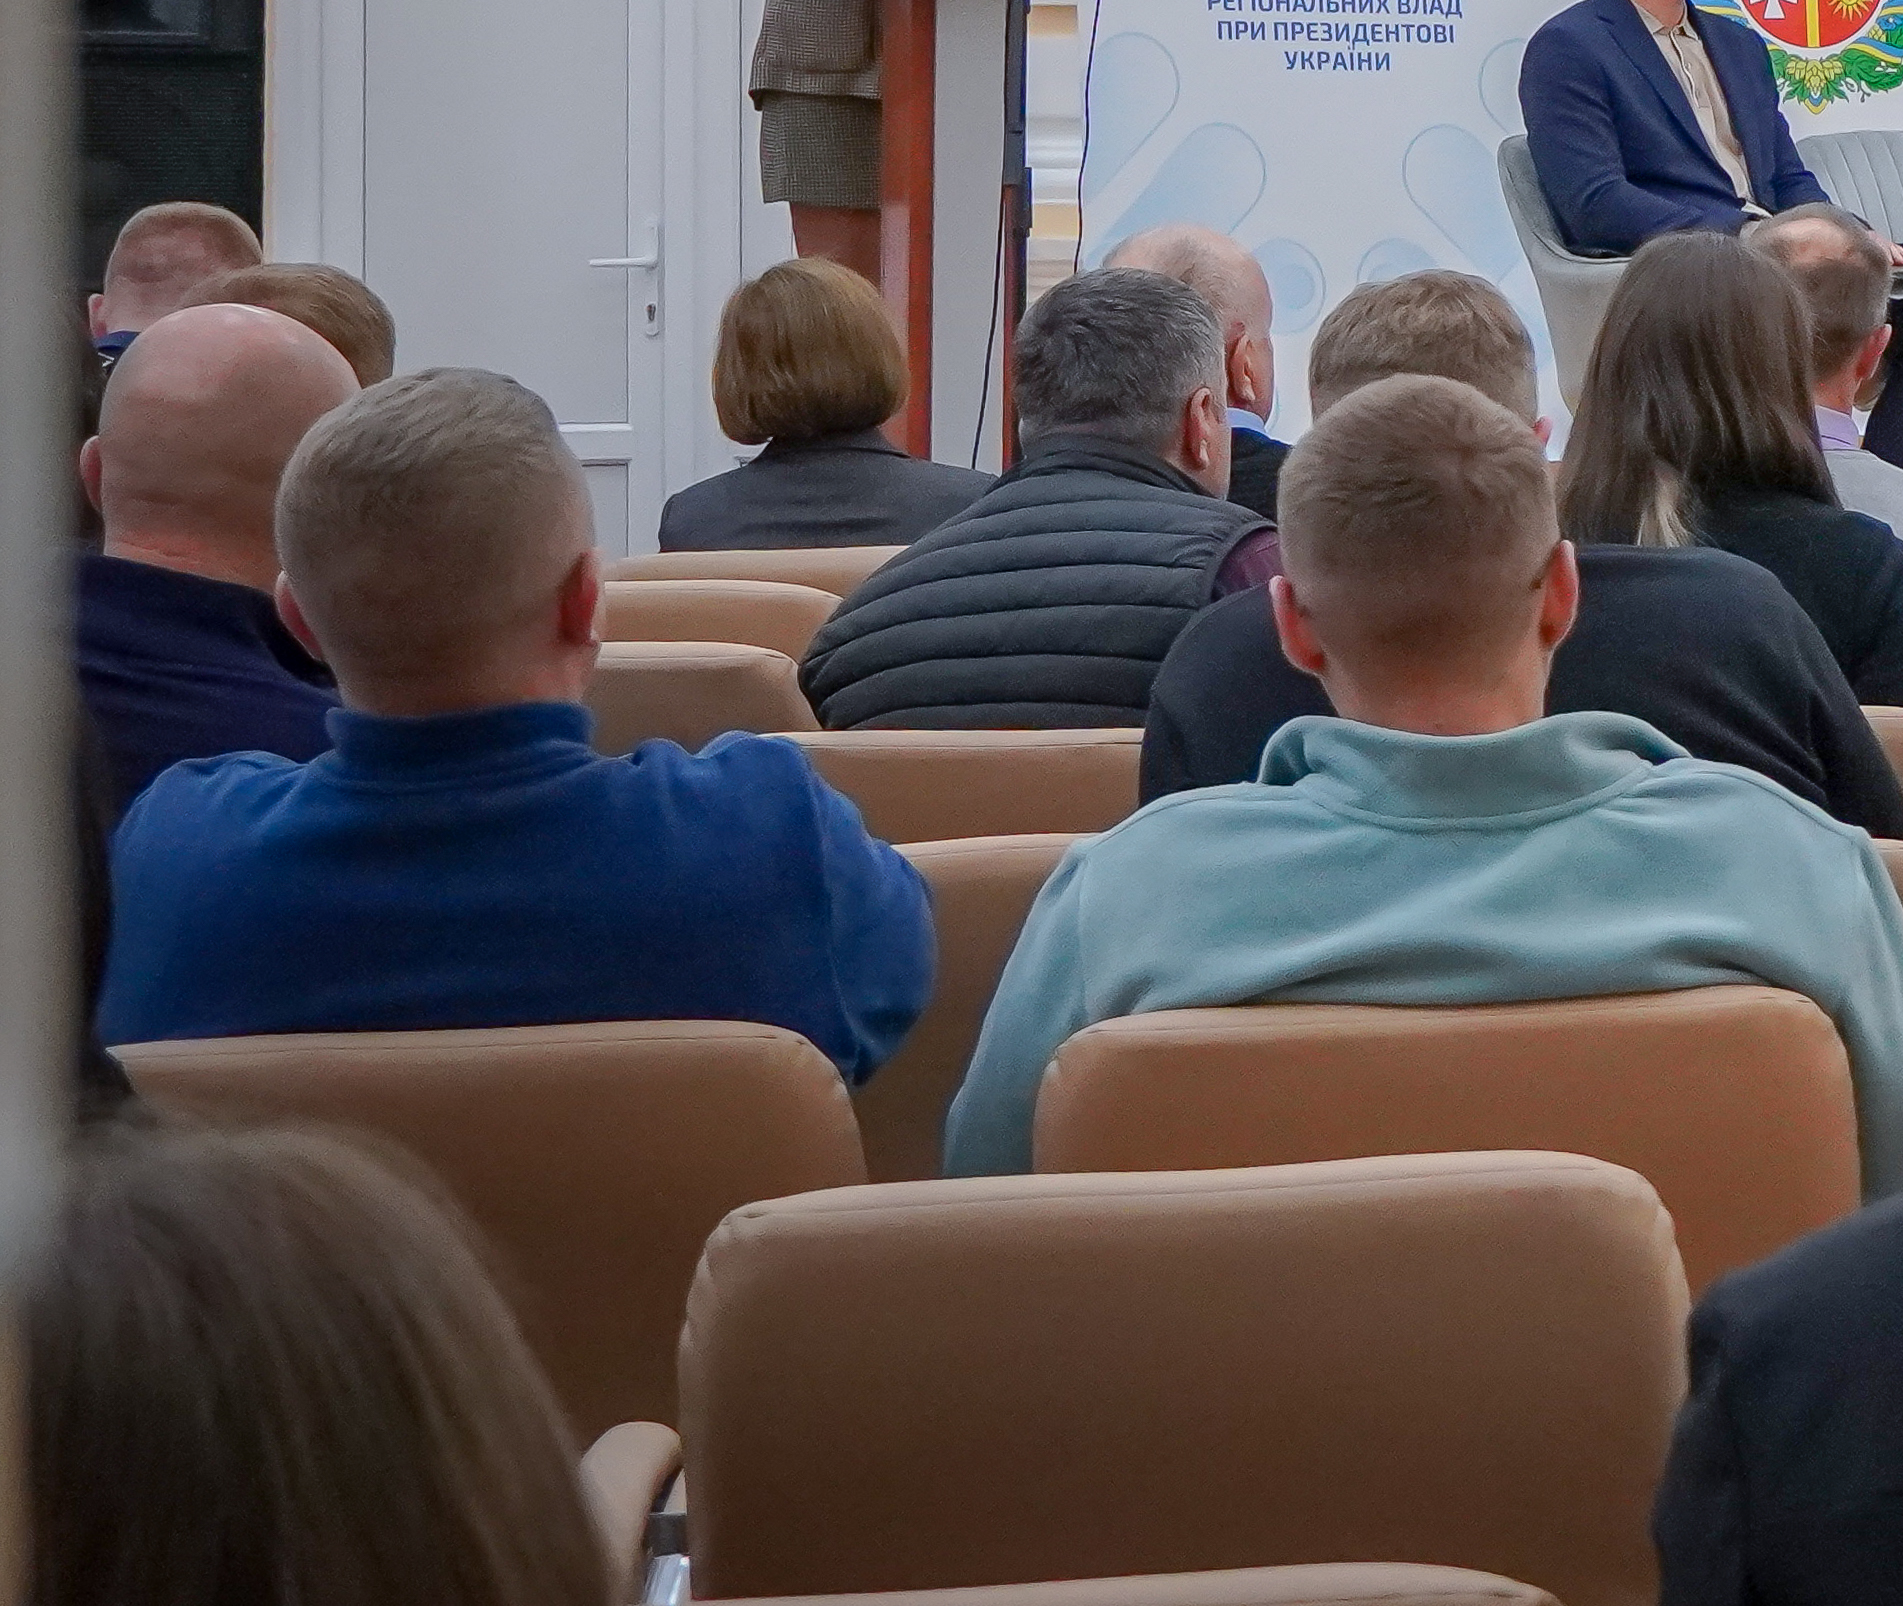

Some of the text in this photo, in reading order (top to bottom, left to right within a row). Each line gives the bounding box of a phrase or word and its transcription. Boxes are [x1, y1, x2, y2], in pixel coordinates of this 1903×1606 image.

[1218, 21, 1454, 50] ПРИ ПРЕЗИДЕНТОВІ
[1284, 40, 1389, 71] УКРАЇНИ
